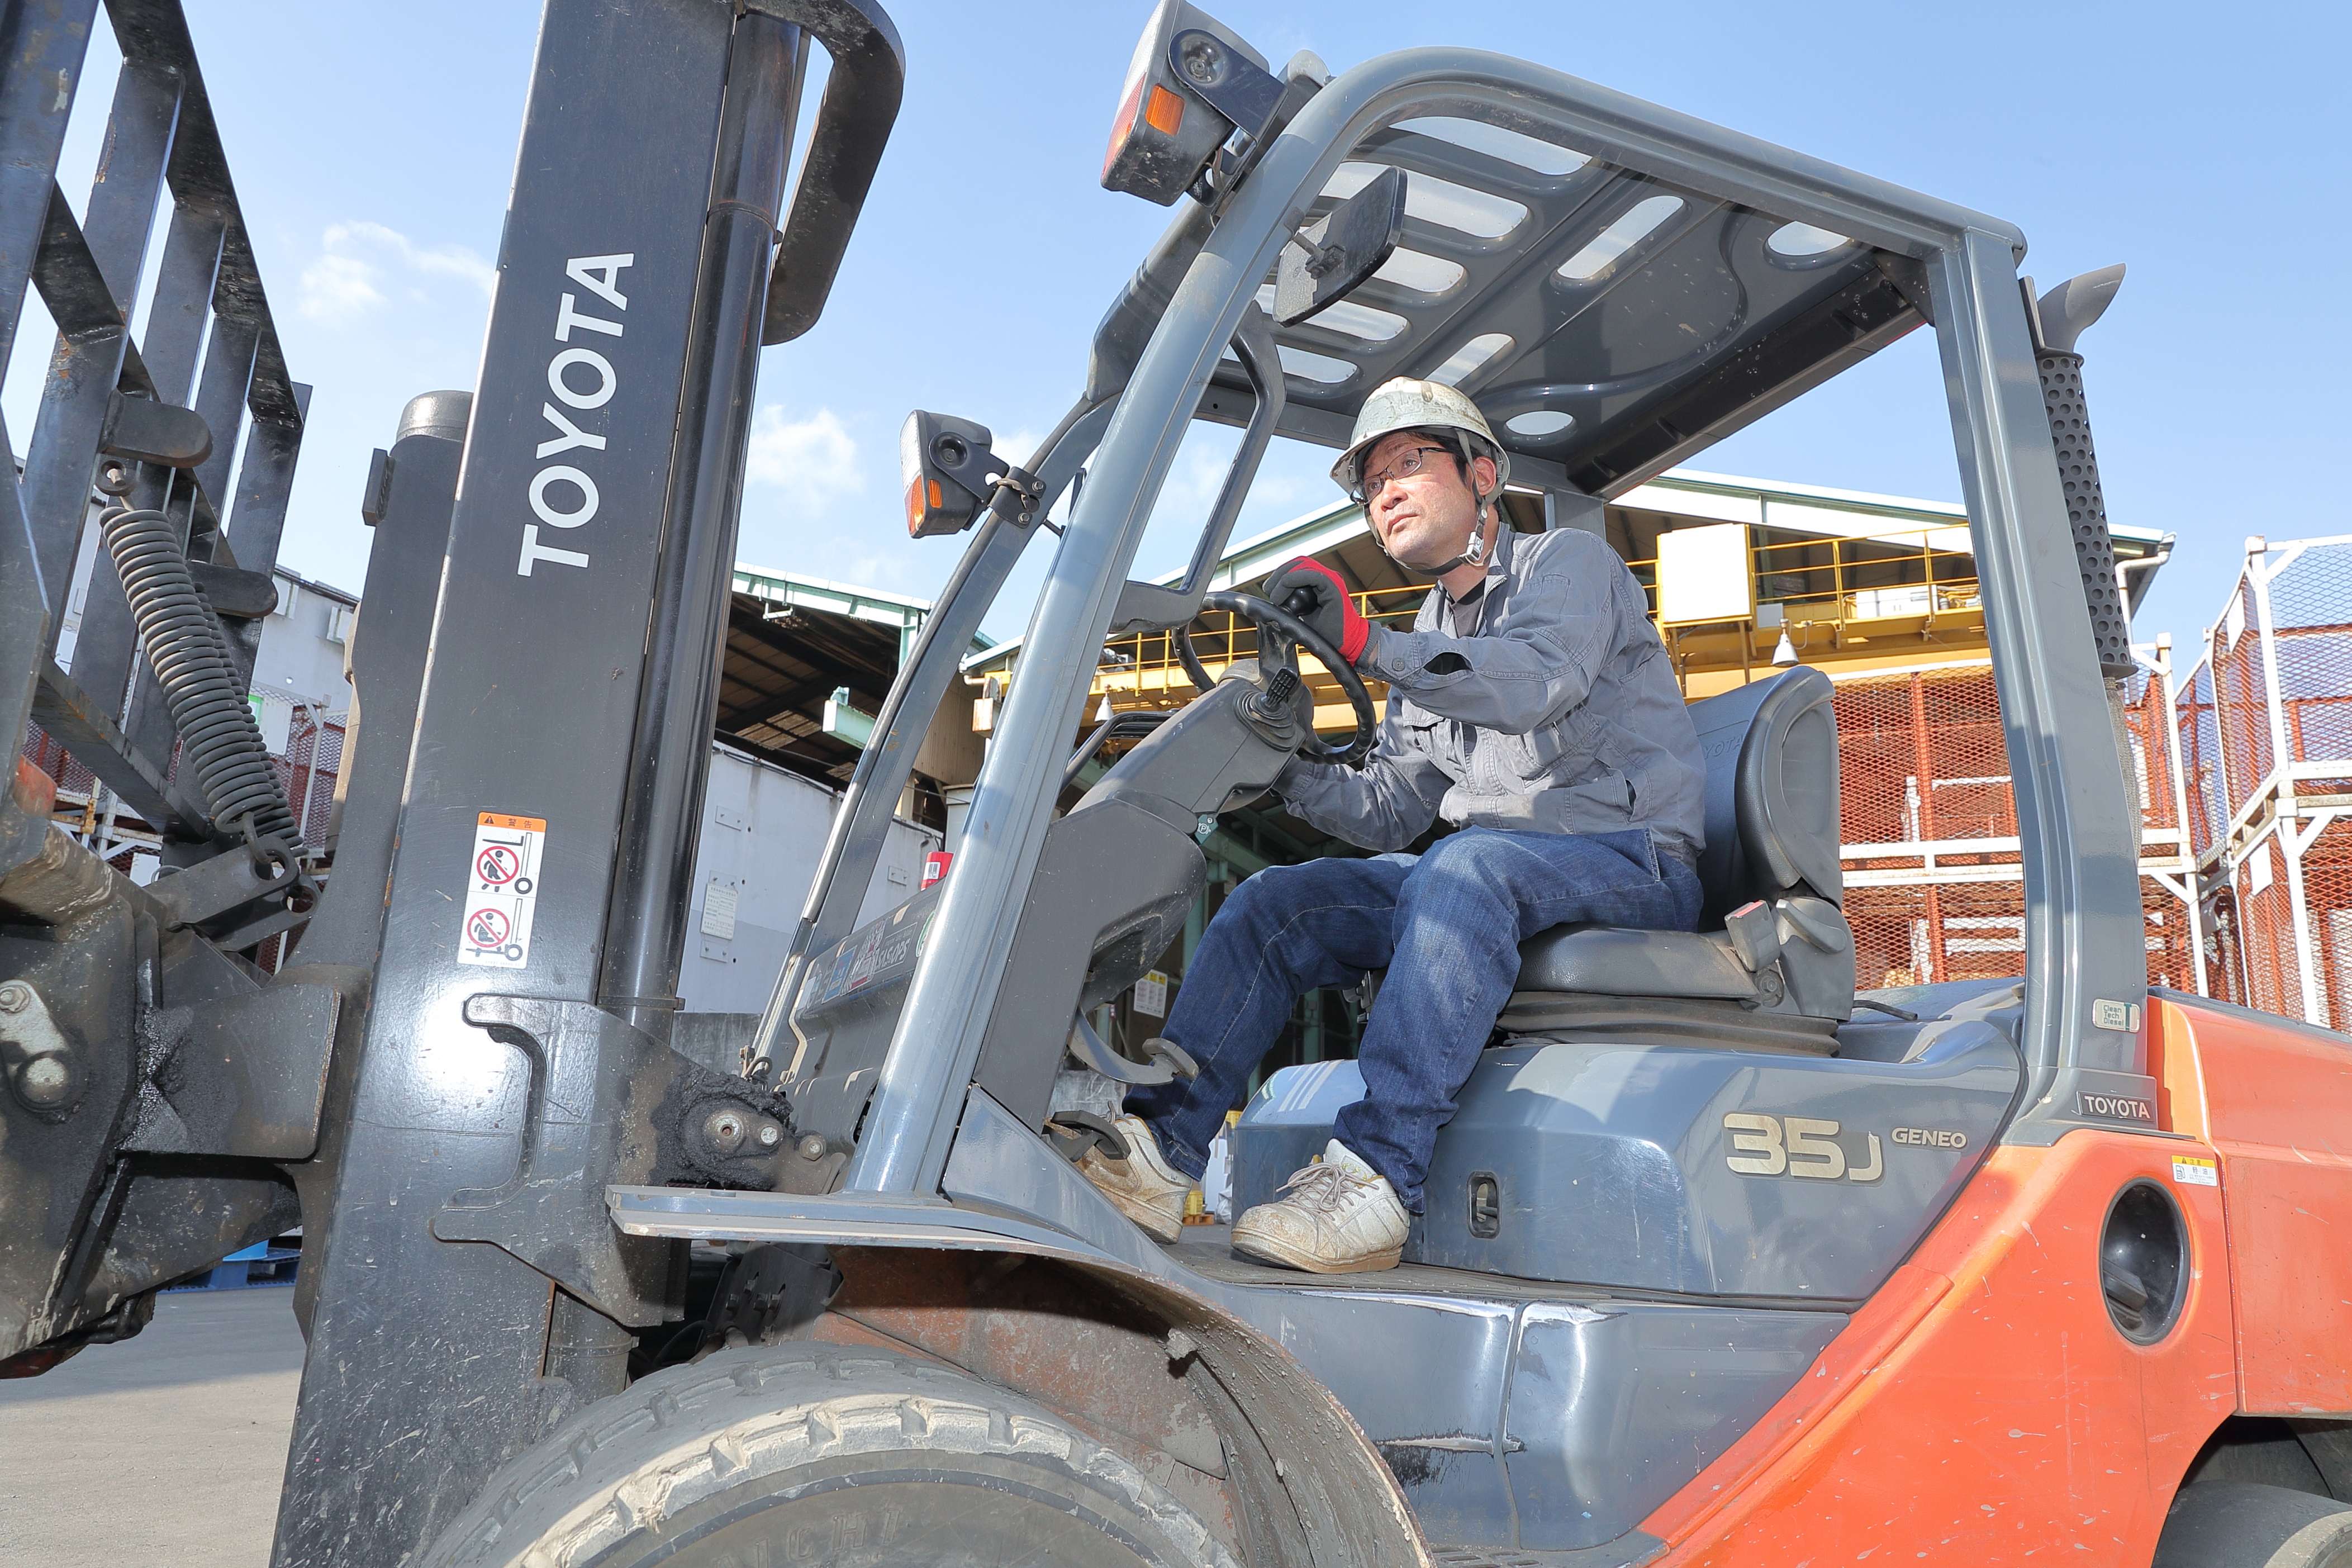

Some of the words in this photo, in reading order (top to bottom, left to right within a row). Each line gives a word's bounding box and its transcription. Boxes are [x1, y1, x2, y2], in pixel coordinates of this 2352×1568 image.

[517, 253, 634, 577] TOYOTA
[1703, 734, 1743, 760] YOTA
[2103, 1005, 2122, 1013] Clean
[2103, 1018, 2124, 1026] Diesel
[2084, 1095, 2150, 1119] TOYOTA
[1724, 1113, 1883, 1181] 35J
[1892, 1128, 1967, 1148] GENEO
